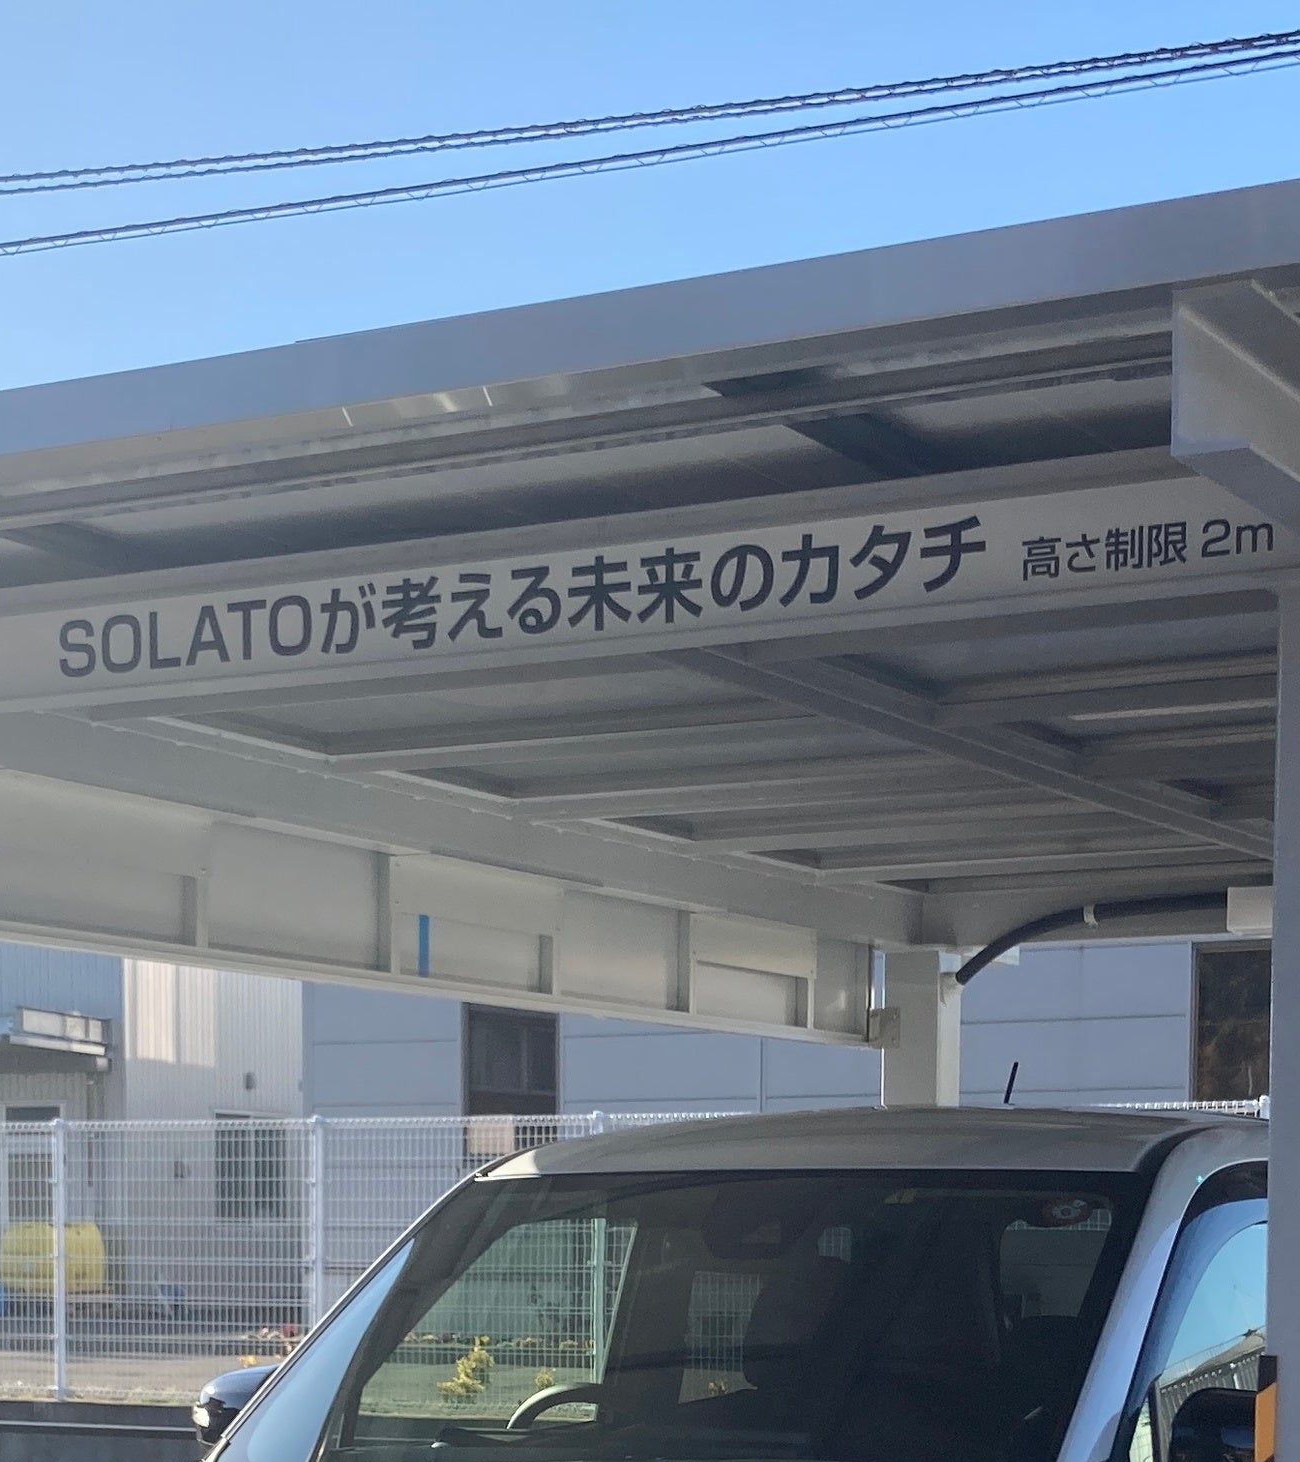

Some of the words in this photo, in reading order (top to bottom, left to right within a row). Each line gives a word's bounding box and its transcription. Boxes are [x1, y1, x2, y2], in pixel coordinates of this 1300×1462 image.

[59, 515, 987, 678] SOLATOが考える未来のカタチ
